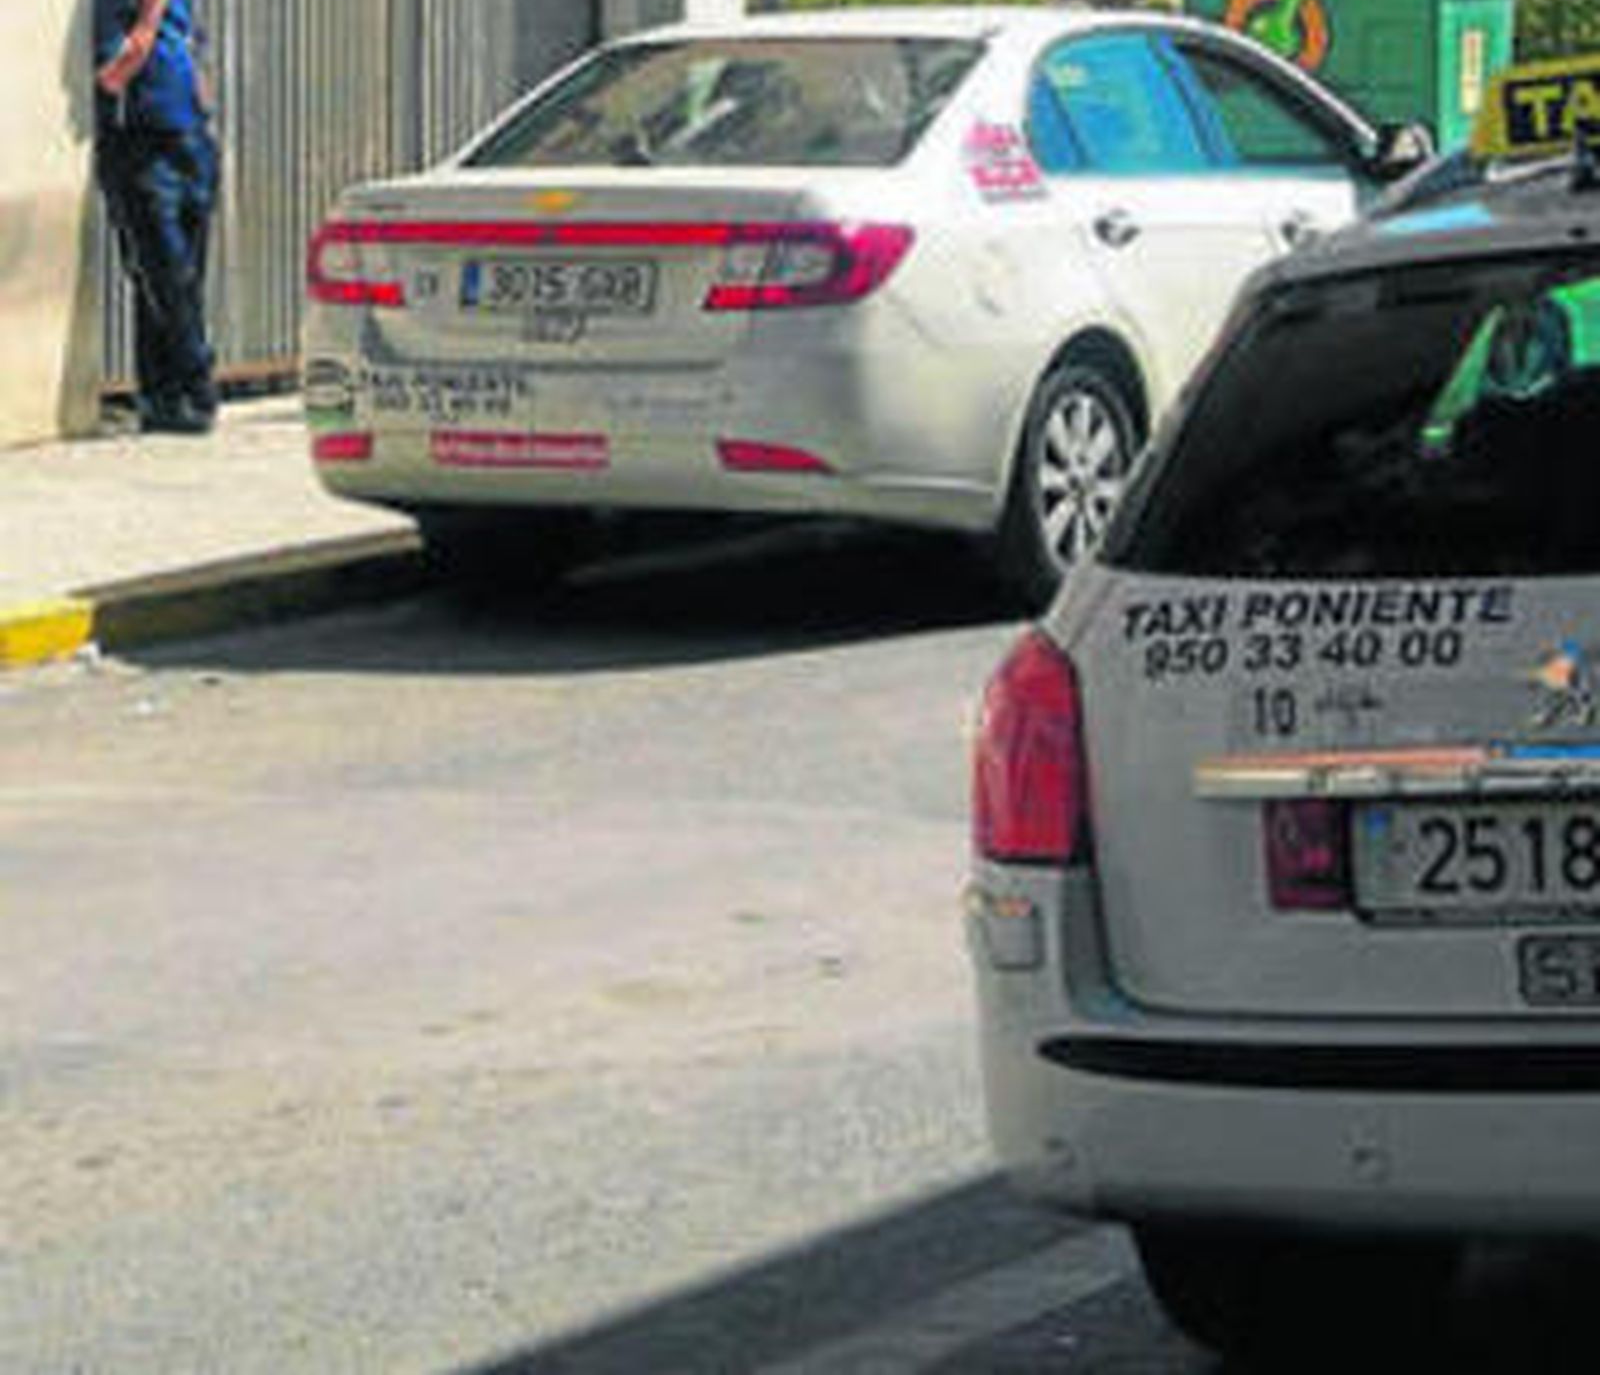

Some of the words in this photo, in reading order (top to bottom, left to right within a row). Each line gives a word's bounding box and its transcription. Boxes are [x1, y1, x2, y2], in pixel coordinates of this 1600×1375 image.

[1122, 594, 1228, 640] TAXI
[1243, 586, 1514, 629] PONIENTE
[1143, 637, 1230, 679] 950
[1242, 633, 1301, 672] 33
[1317, 629, 1382, 668] 40
[1399, 628, 1463, 667] 00
[1251, 687, 1297, 736] 10
[1416, 816, 1600, 894] 2518
